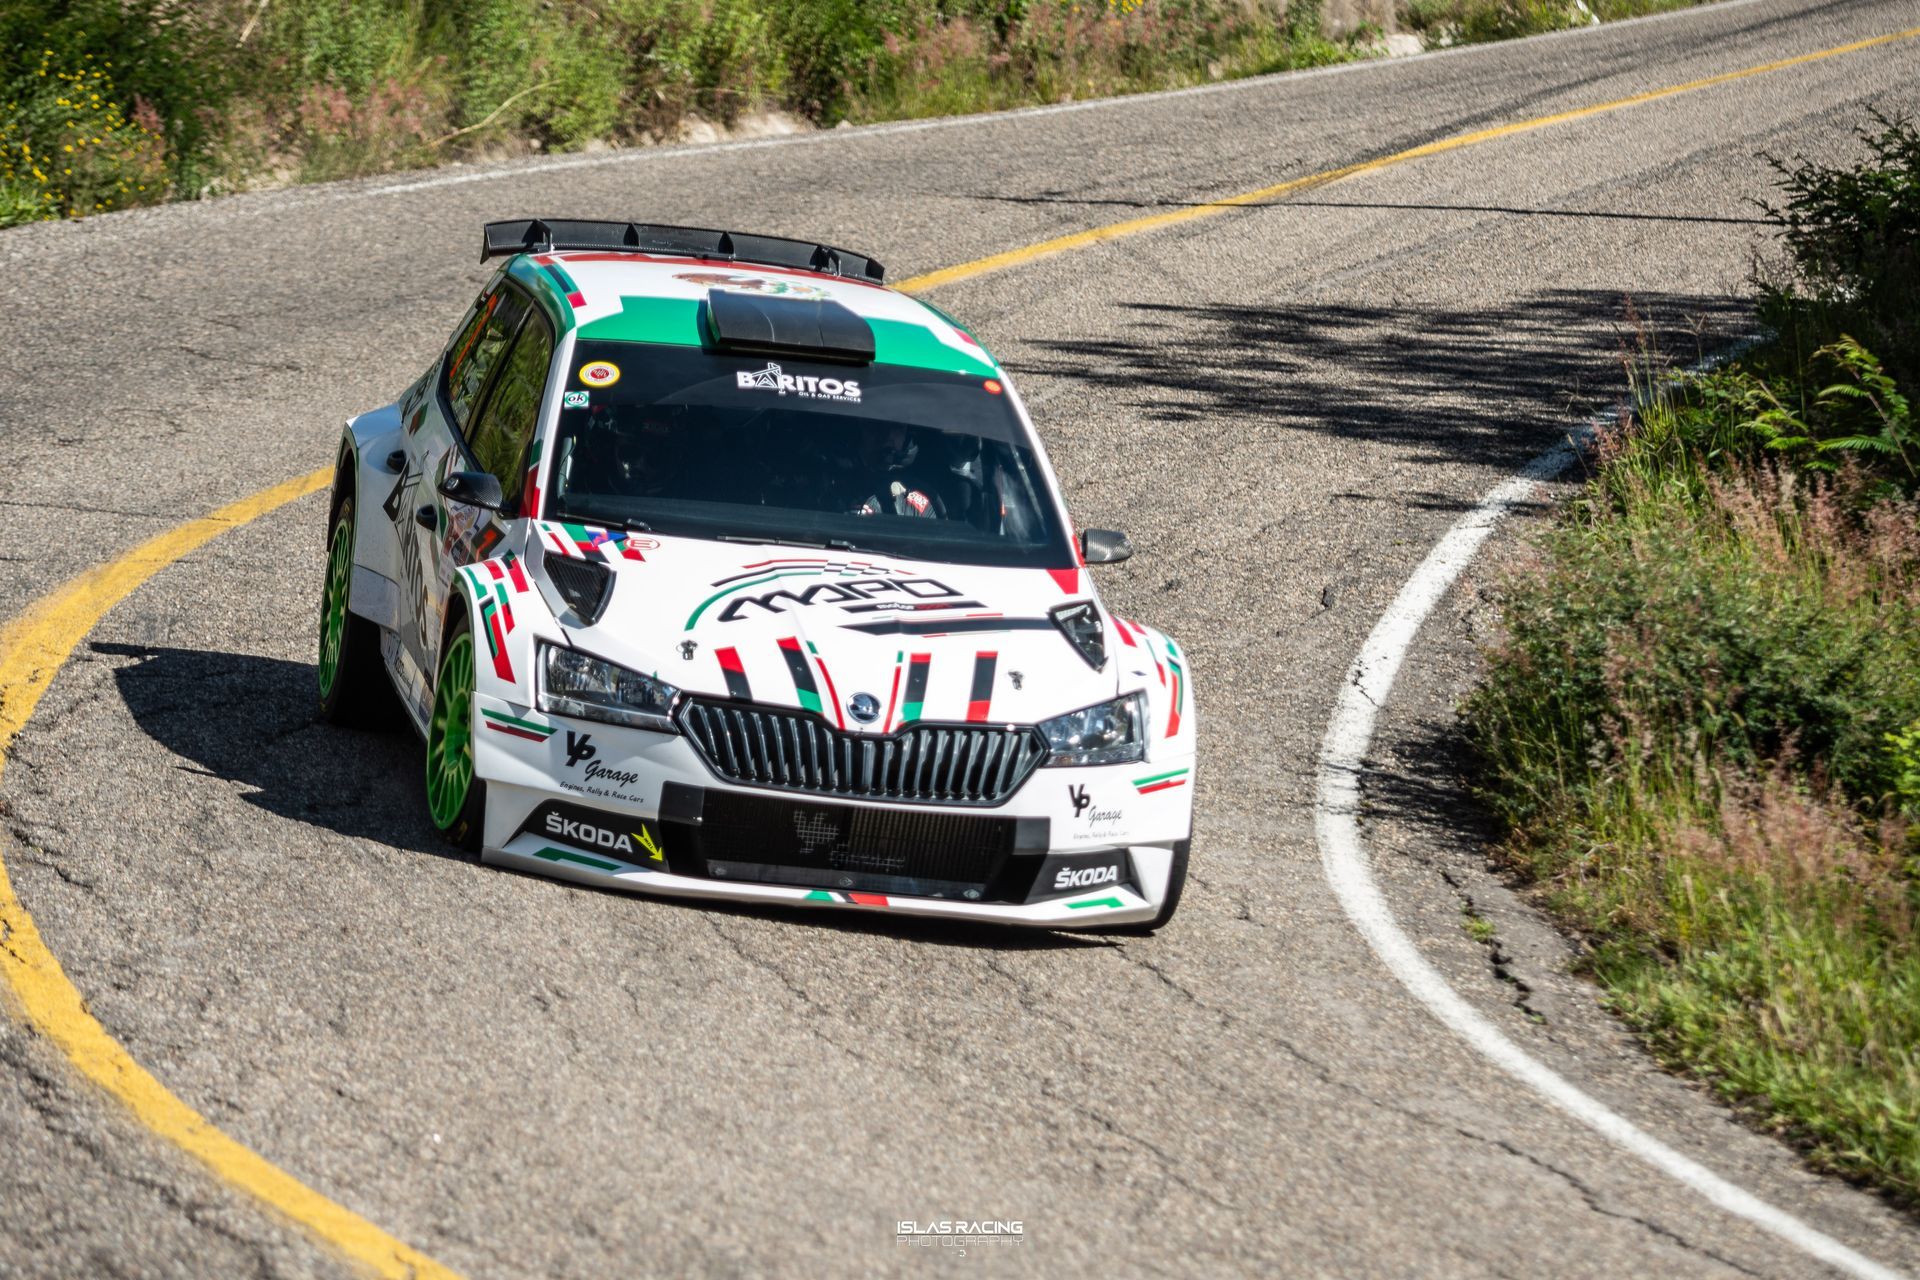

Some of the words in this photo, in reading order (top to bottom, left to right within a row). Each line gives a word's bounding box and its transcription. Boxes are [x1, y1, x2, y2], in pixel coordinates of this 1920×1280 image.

[737, 362, 862, 398] BARITOS
[584, 759, 639, 787] Garage
[587, 786, 603, 797] Rally
[629, 795, 645, 804] Cars
[545, 811, 633, 853] ŠKODA
[1054, 865, 1118, 888] ŠKODA
